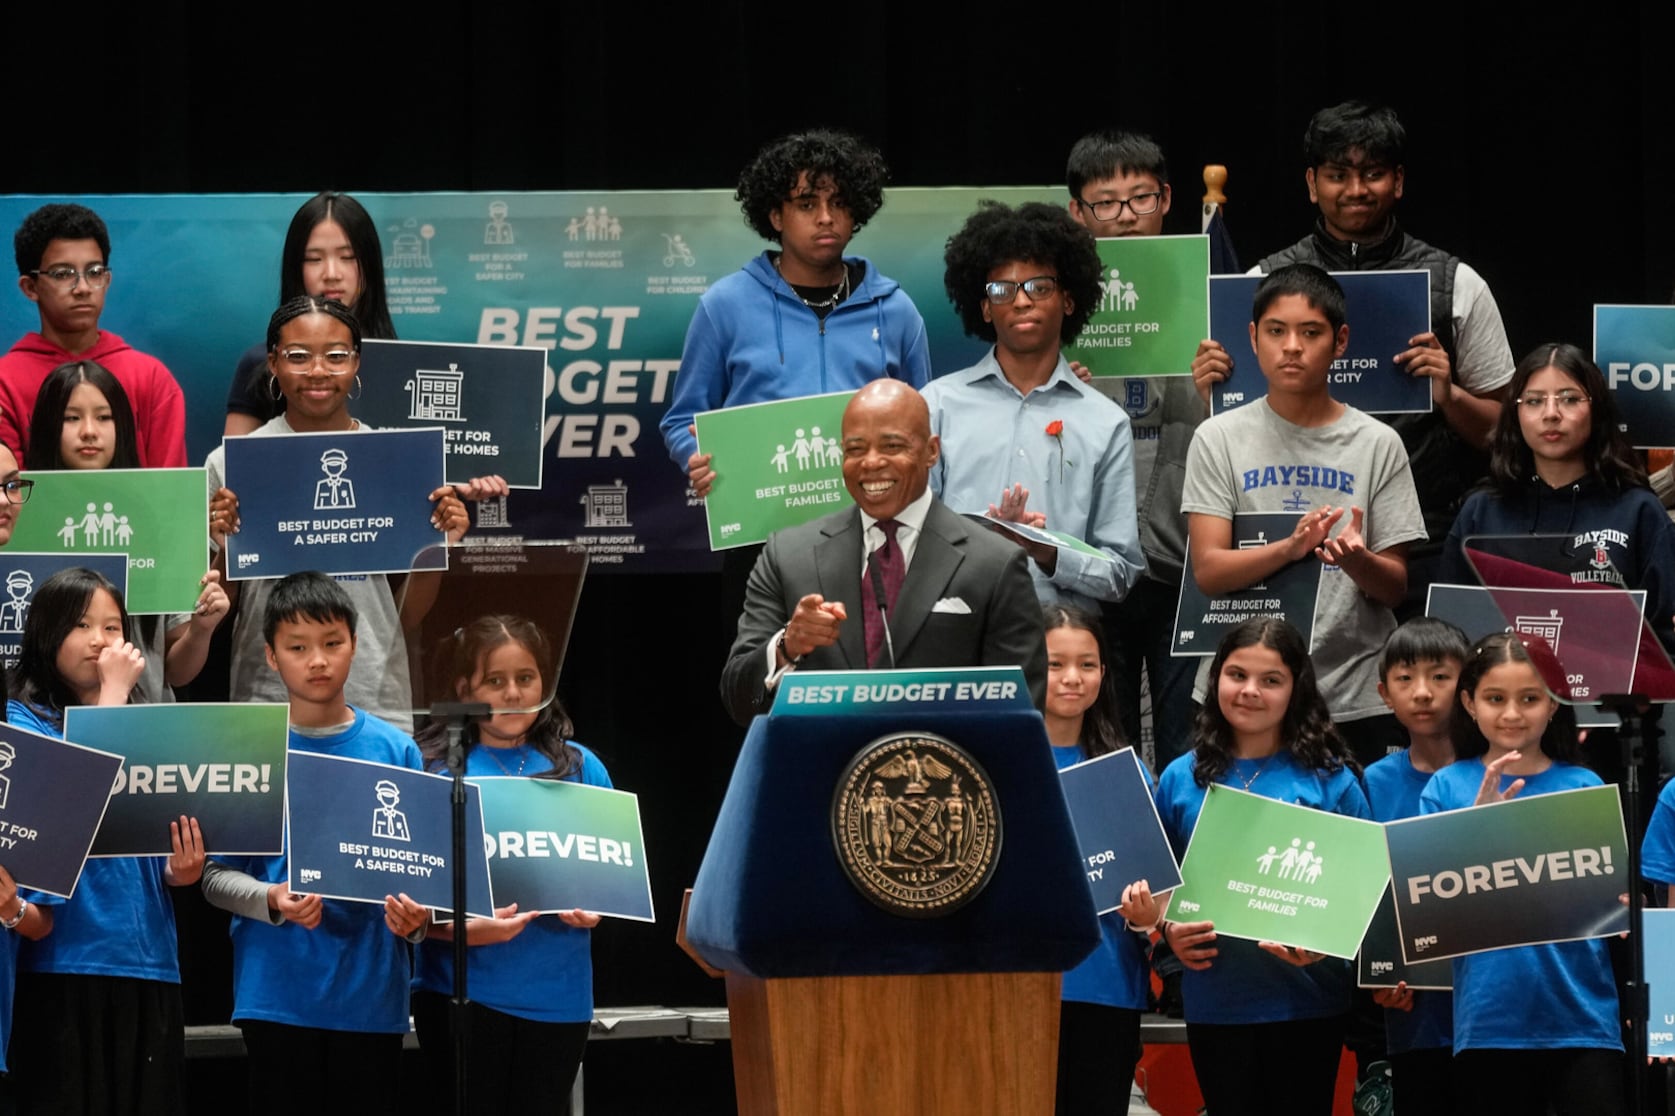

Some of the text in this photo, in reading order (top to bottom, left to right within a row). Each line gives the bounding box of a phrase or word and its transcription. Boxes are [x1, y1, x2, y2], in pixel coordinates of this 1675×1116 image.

[477, 306, 640, 351] BEST
[1134, 322, 1160, 334] FOR
[1077, 336, 1132, 348] FAMILIES
[1351, 359, 1379, 370] FOR
[1334, 372, 1362, 383] CITY
[465, 431, 491, 442] FOR
[454, 444, 499, 456] HOMES
[1243, 465, 1355, 496] BAYSIDE
[755, 485, 786, 499] BEST
[789, 479, 839, 495] BUDGET
[785, 492, 841, 508] FAMILIES
[278, 517, 394, 532] BEST BUDGET FOR
[294, 531, 378, 546] A SAFER CITY
[576, 535, 636, 545] BEST BUDGET
[1573, 529, 1630, 549] BAYSIDE
[588, 545, 645, 554] AFFORDABLE
[129, 558, 155, 569] FOR
[591, 555, 624, 563] HOMES
[1210, 599, 1281, 610] BEST BUDGET FOR
[788, 682, 1018, 704] BEST BUDGET EVER
[9, 824, 38, 841] FOR
[339, 842, 445, 868] BEST BUDGET FOR
[1088, 850, 1116, 867] FOR
[355, 858, 433, 878] A SAFER CITY
[1407, 846, 1615, 905] FOREVER!
[1227, 880, 1328, 909] BEST BUDGET FOR
[1247, 899, 1298, 917] FAMILIES
[1414, 935, 1437, 948] NYC
[1371, 962, 1393, 971] NYC
